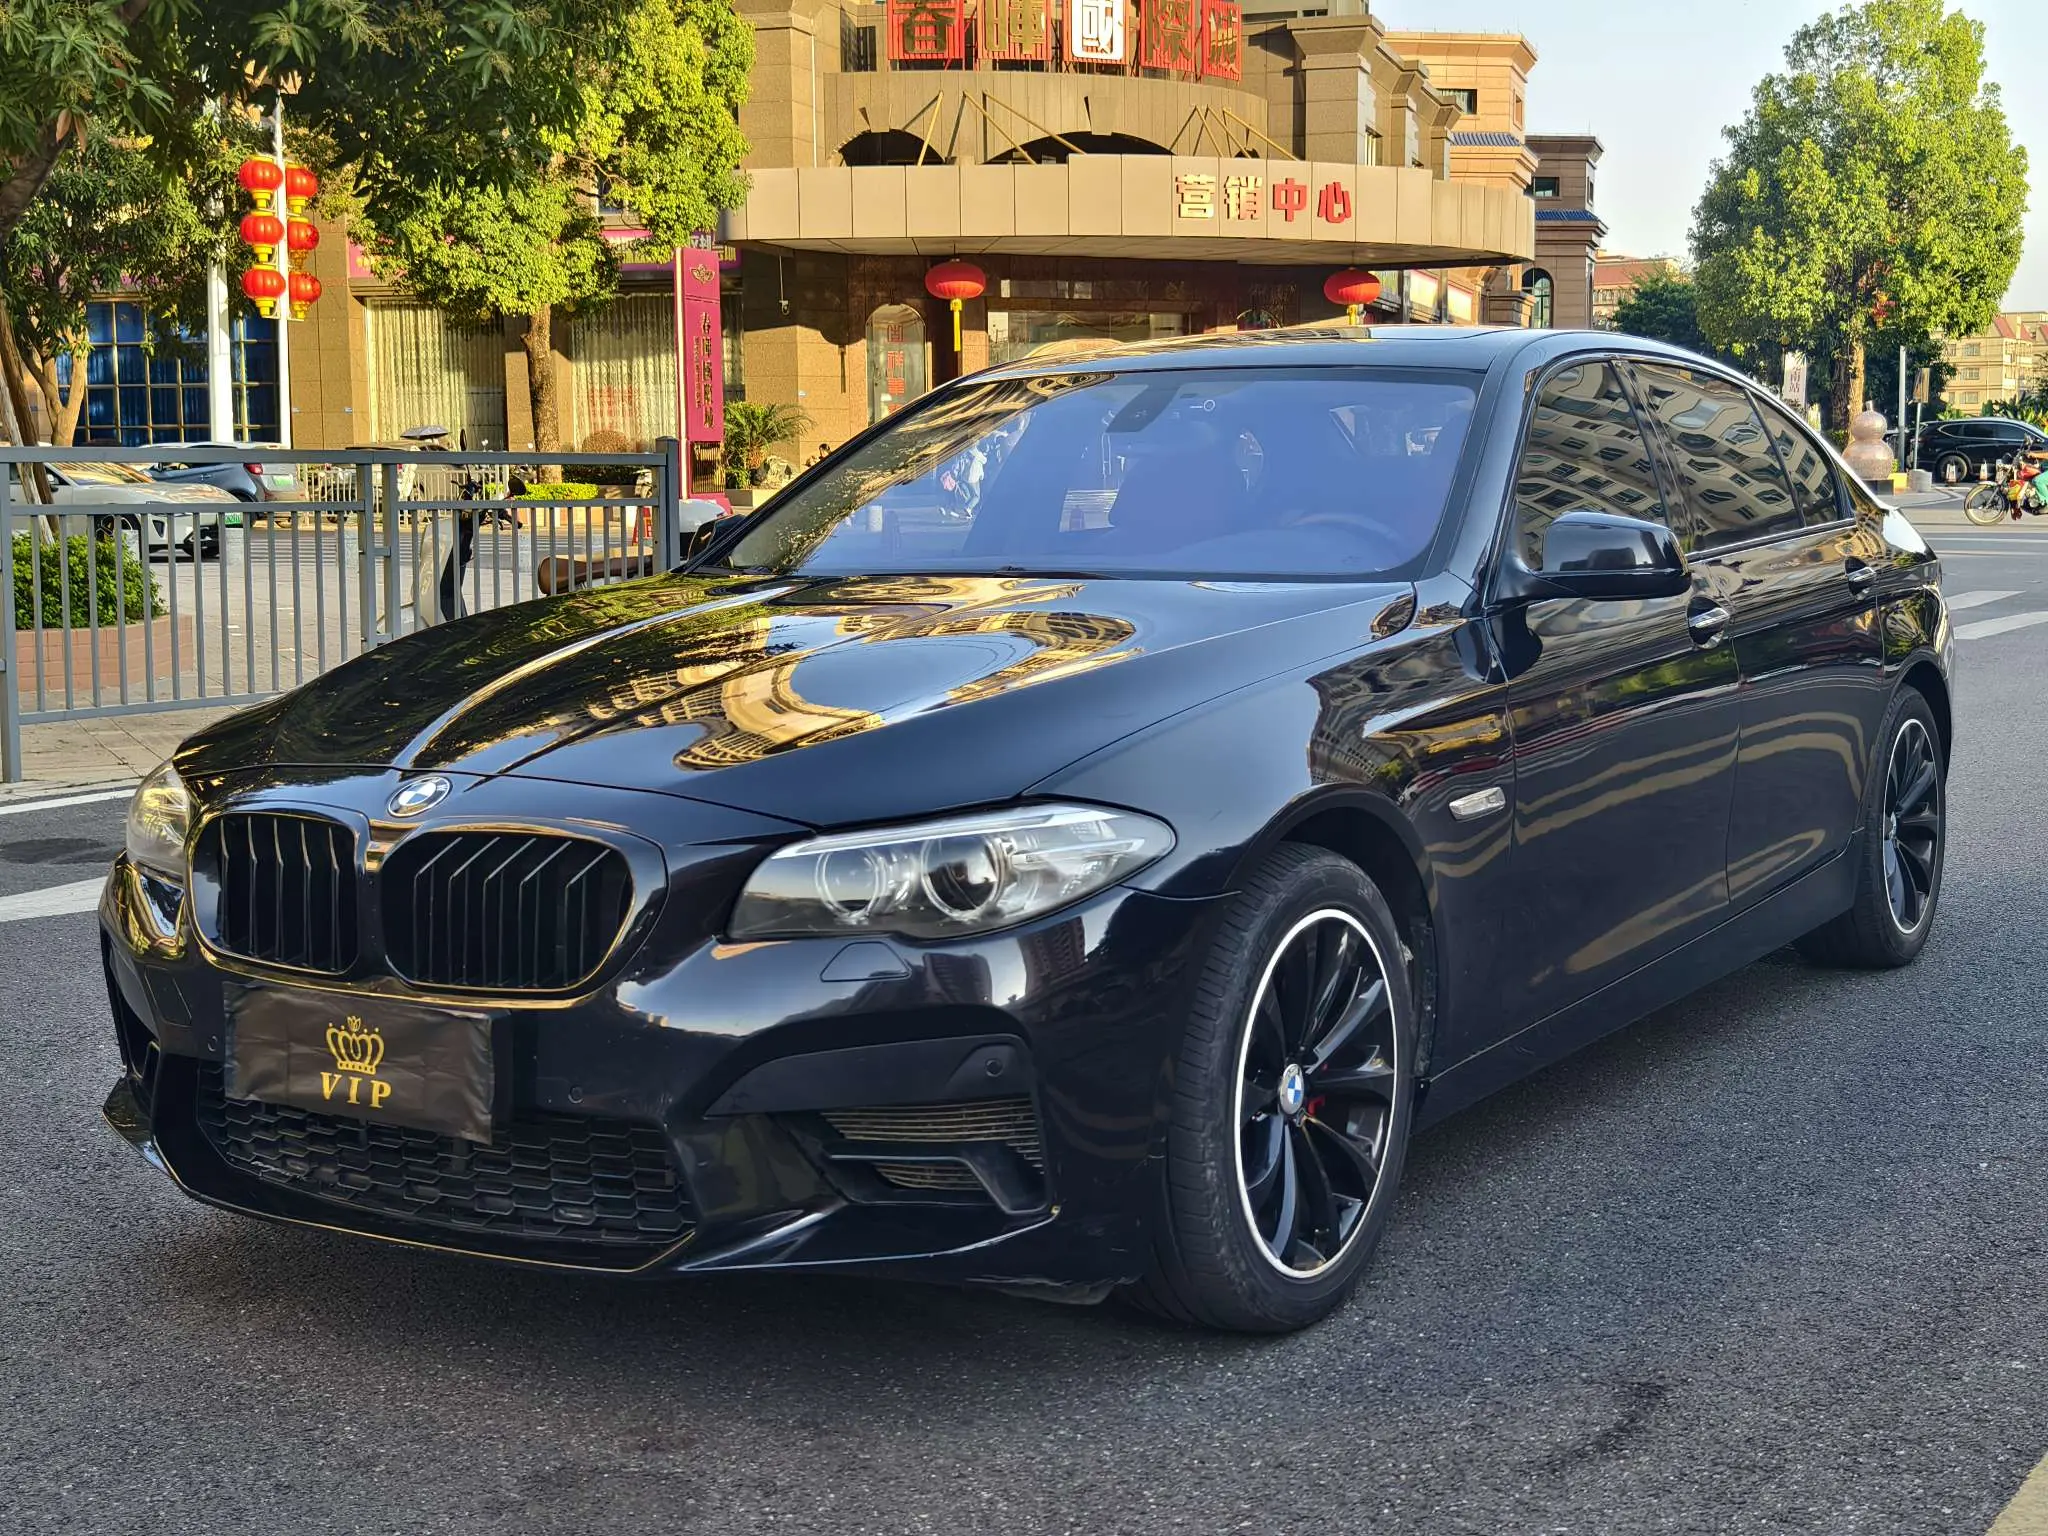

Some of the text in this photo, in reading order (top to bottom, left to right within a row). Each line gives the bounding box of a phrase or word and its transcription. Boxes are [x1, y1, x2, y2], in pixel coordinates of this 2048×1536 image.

[1176, 174, 1352, 223] 营销中心
[320, 1071, 392, 1109] VIP
